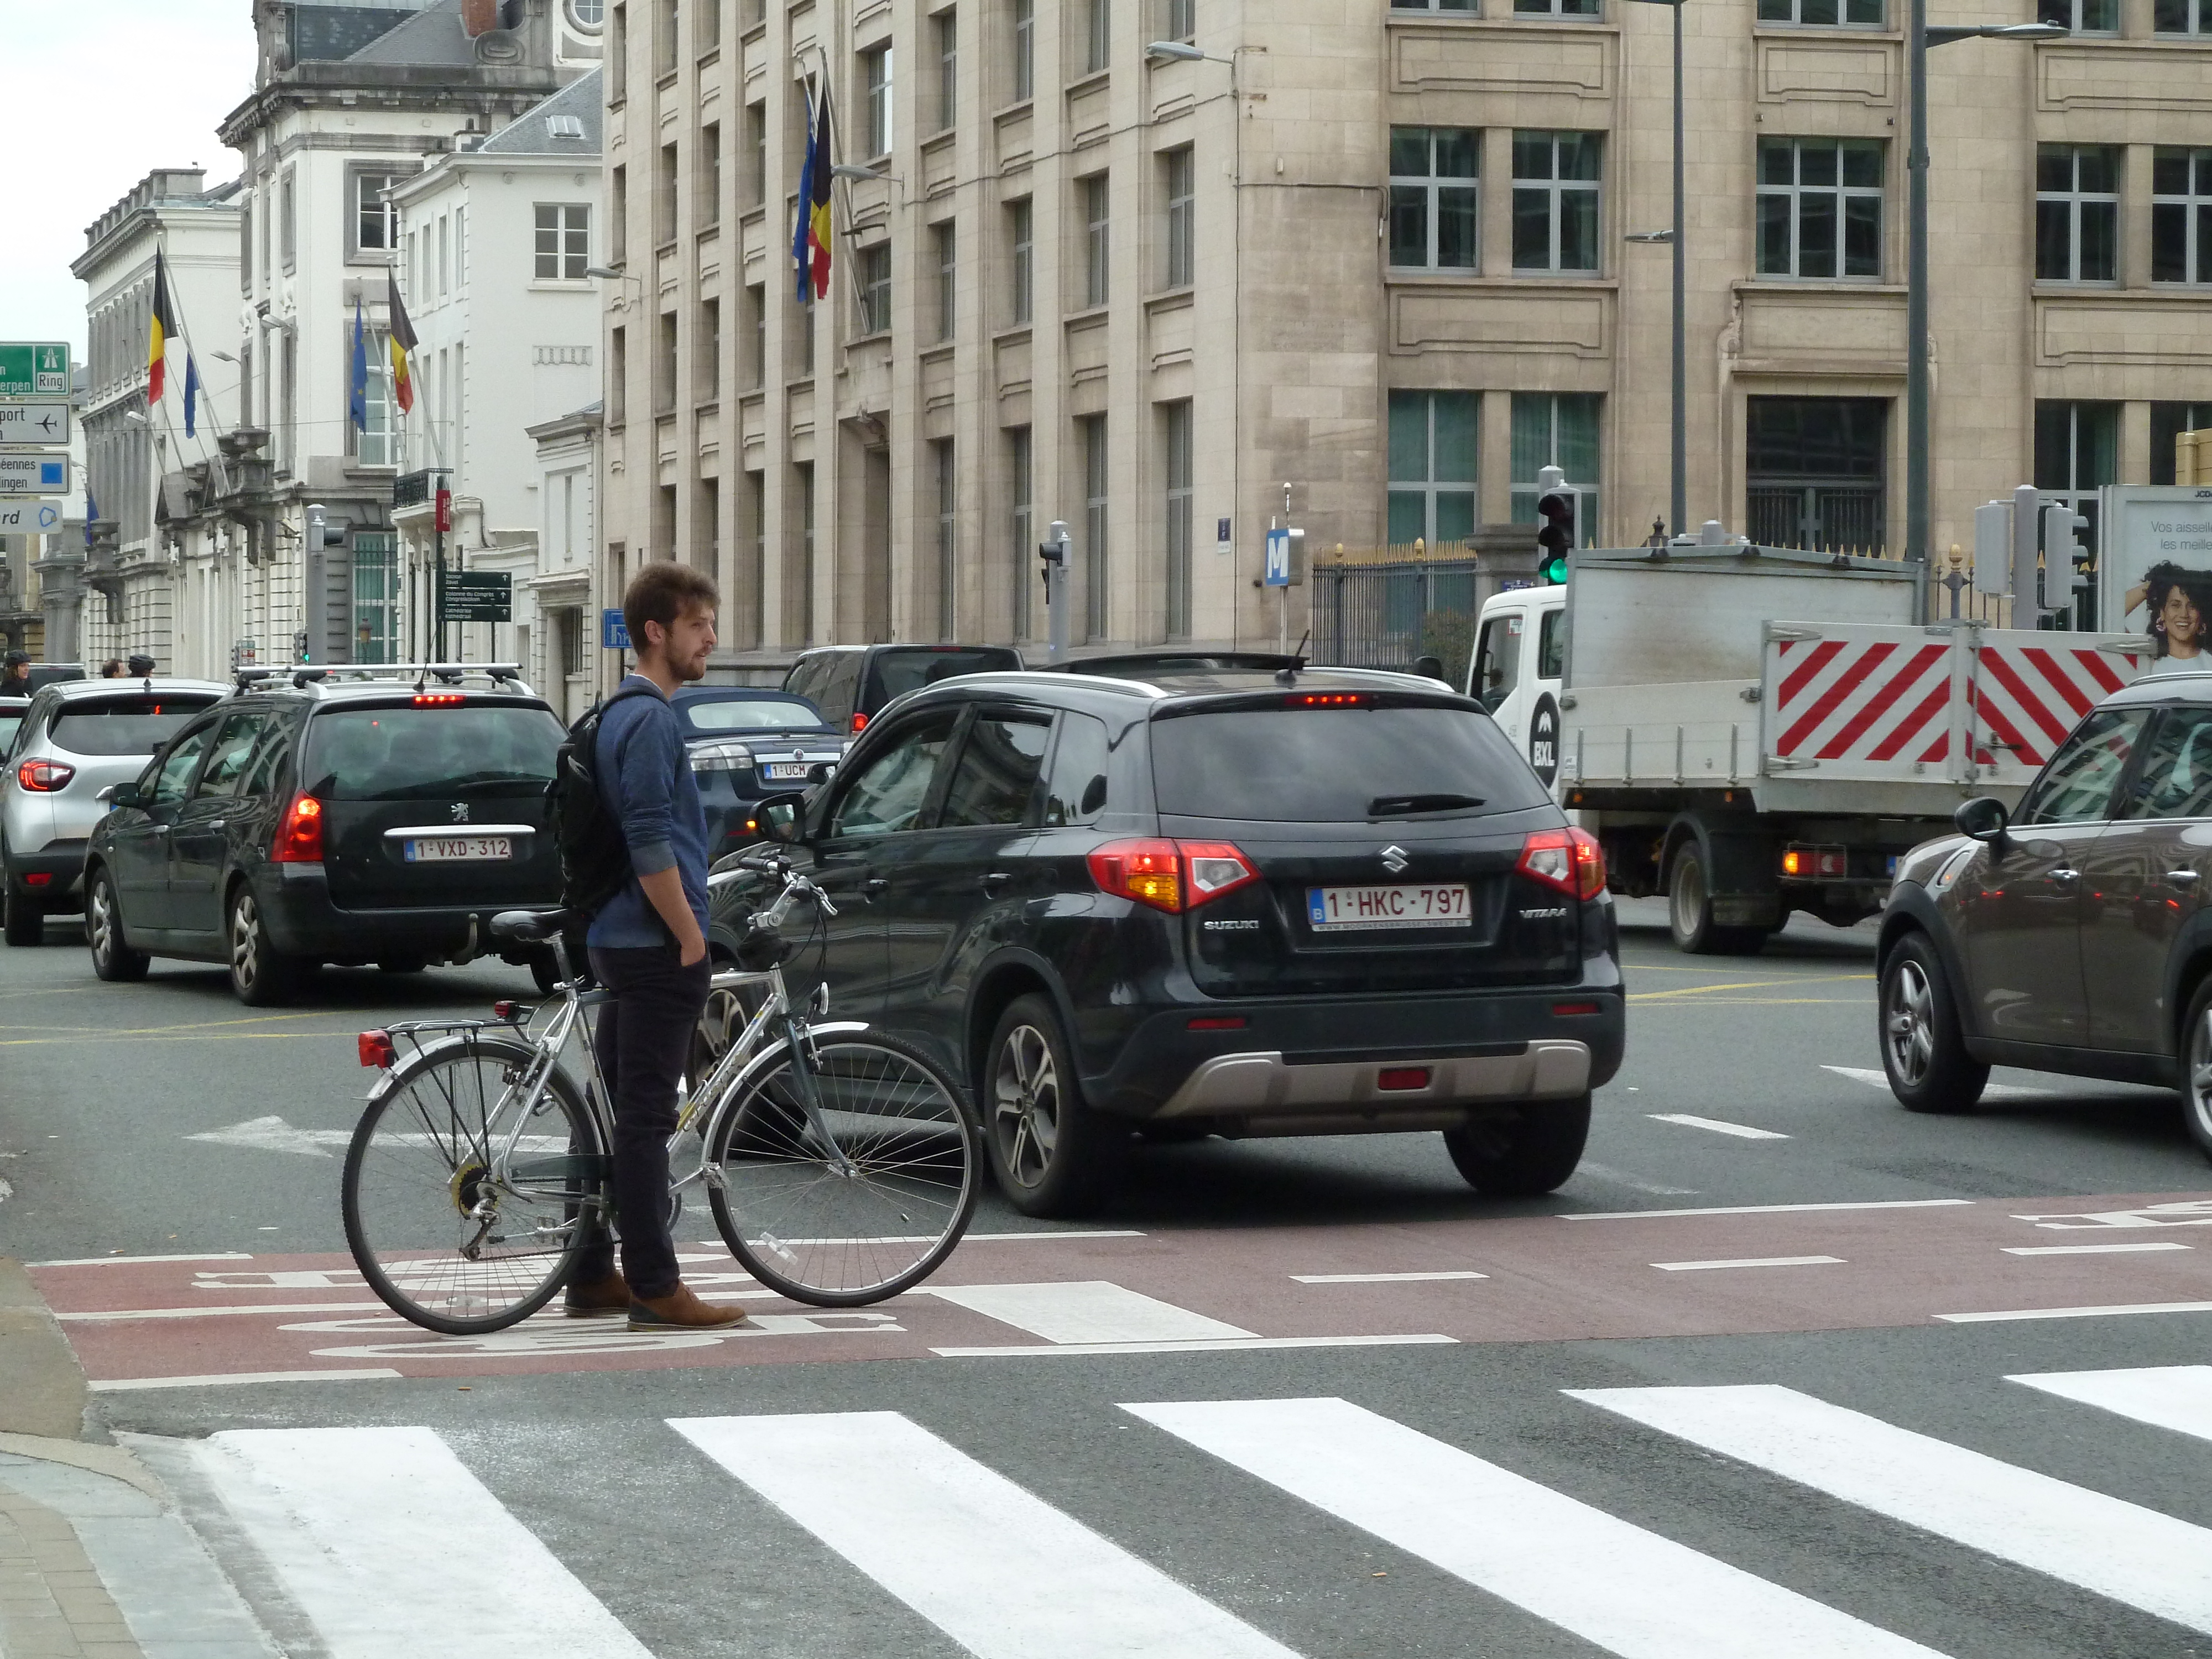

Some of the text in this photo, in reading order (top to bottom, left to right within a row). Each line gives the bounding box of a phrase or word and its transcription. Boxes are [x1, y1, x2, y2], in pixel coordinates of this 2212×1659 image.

[39, 374, 63, 389] Ring
[0, 407, 25, 425] port
[0, 458, 36, 469] éennes
[0, 510, 20, 524] rd
[2151, 521, 2212, 533] Vos aissell
[2161, 539, 2177, 550] les
[1267, 536, 1288, 578] M
[1534, 741, 1555, 766] BXL
[418, 839, 508, 857] 1-VXD-312
[1313, 889, 1465, 920] B 1-HKC-797
[1519, 908, 1567, 918] VITARA
[1204, 920, 1259, 930] SUZUKI
